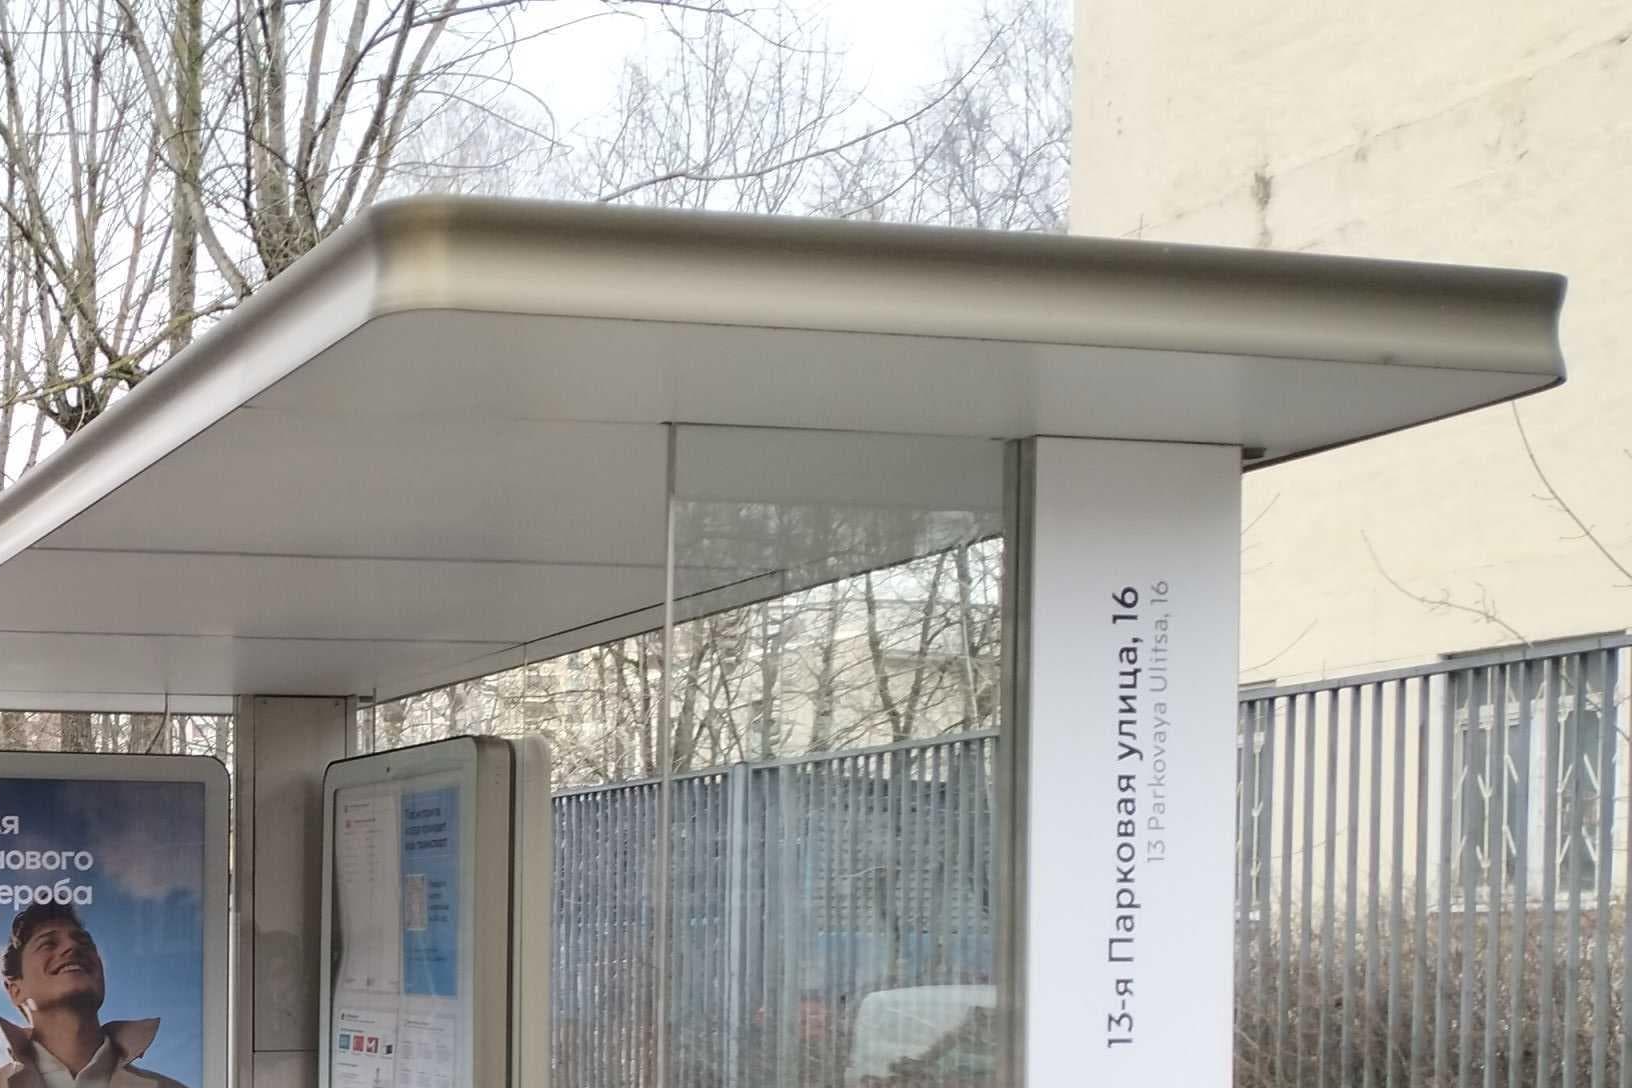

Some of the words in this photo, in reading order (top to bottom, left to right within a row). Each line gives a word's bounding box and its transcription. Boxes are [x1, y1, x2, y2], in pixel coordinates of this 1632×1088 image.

[1111, 586, 1139, 625] 16
[1149, 580, 1169, 605] 16
[1148, 613, 1172, 693] Ulitsa,
[1117, 636, 1144, 761] улица,
[1146, 701, 1172, 831] Parkovaya
[1108, 774, 1142, 963] Парковая
[1146, 839, 1166, 864] 13
[1107, 978, 1135, 1049] 13-я
